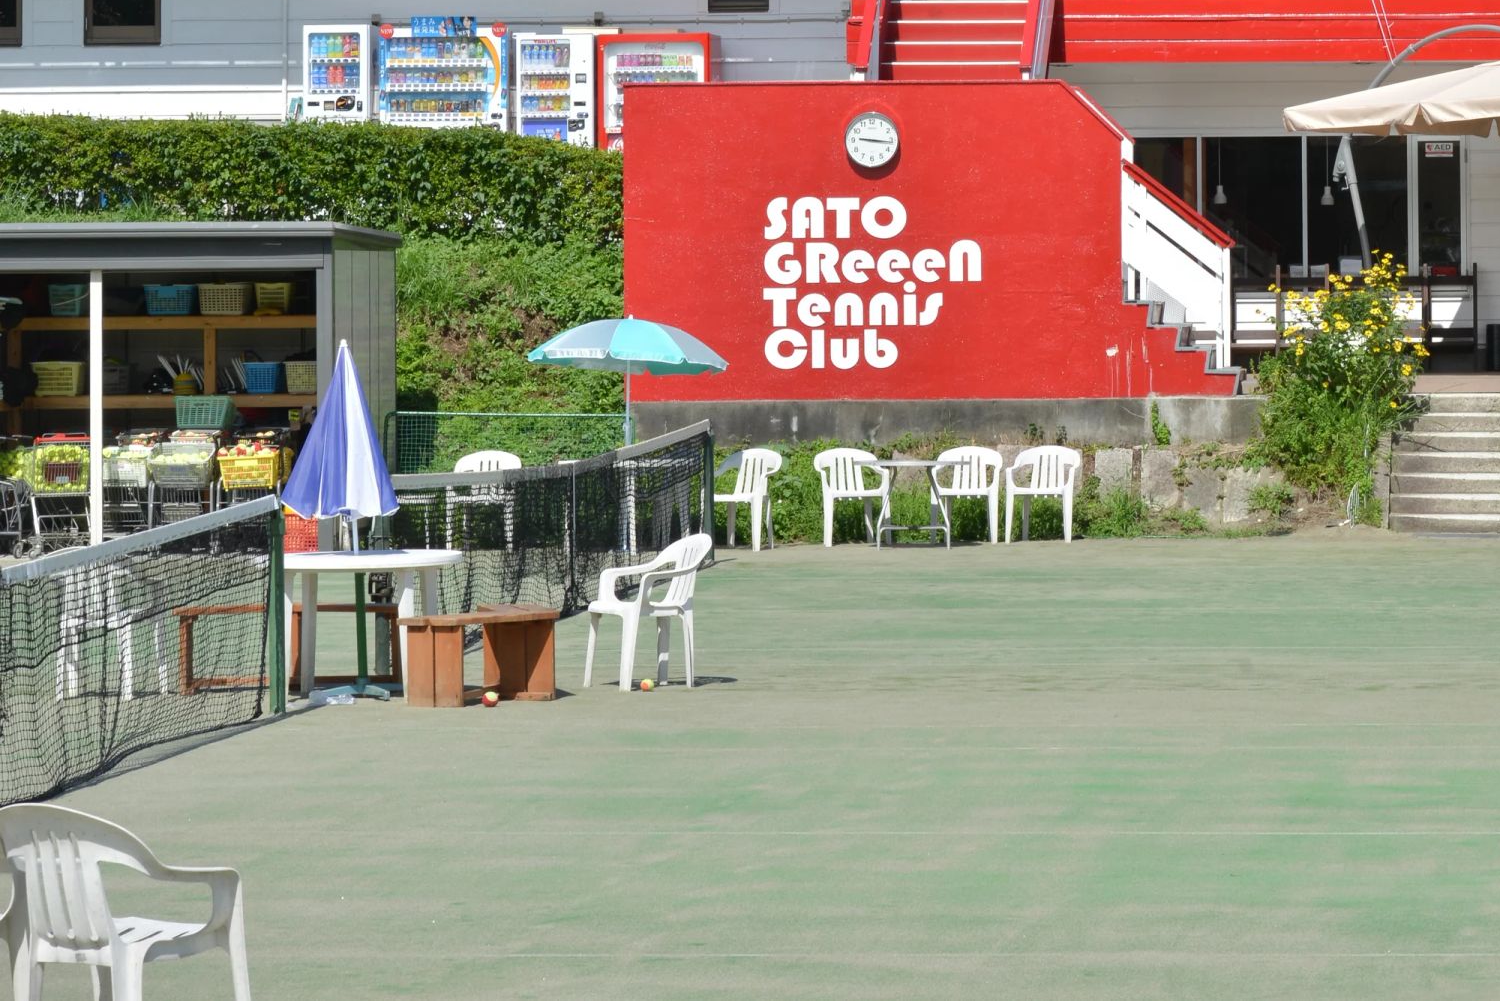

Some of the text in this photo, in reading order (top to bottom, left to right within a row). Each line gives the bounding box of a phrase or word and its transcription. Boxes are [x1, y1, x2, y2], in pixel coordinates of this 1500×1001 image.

[763, 196, 908, 239] SATO
[763, 281, 944, 327] Tennis
[764, 327, 899, 370] Club
